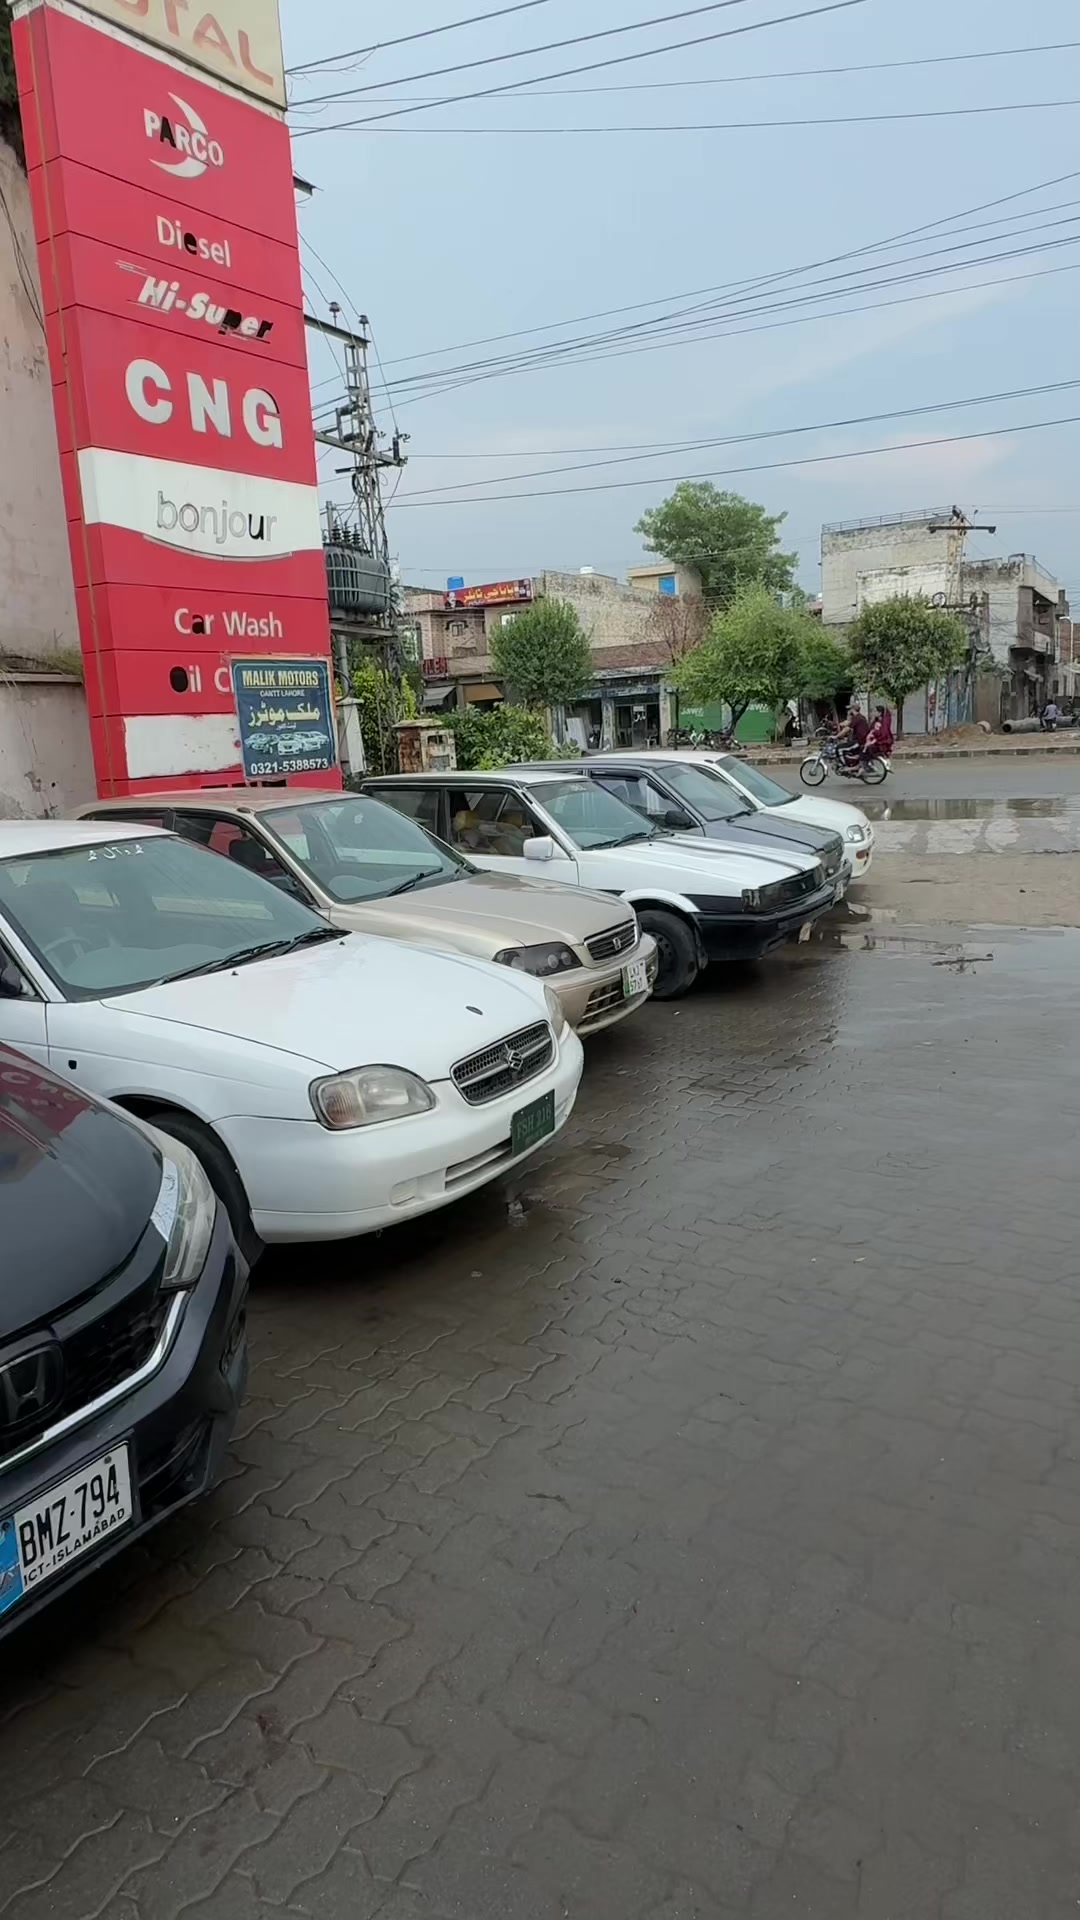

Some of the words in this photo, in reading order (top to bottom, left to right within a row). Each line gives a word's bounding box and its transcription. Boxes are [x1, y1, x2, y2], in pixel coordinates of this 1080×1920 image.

[143, 108, 225, 167] PARCO
[156, 215, 232, 267] Diesel
[137, 275, 274, 338] Hi-Super
[125, 358, 283, 448] CNG
[157, 491, 277, 544] bonjour
[174, 608, 214, 636] Car
[222, 611, 283, 638] Wash
[169, 665, 202, 693] Oil
[242, 670, 276, 686] MALIK
[278, 670, 319, 686] MOTORS
[250, 758, 329, 775] 0321-5388573
[19, 1464, 119, 1568] BMZ-794
[24, 1508, 125, 1586] ICT-ISLAMABAD
